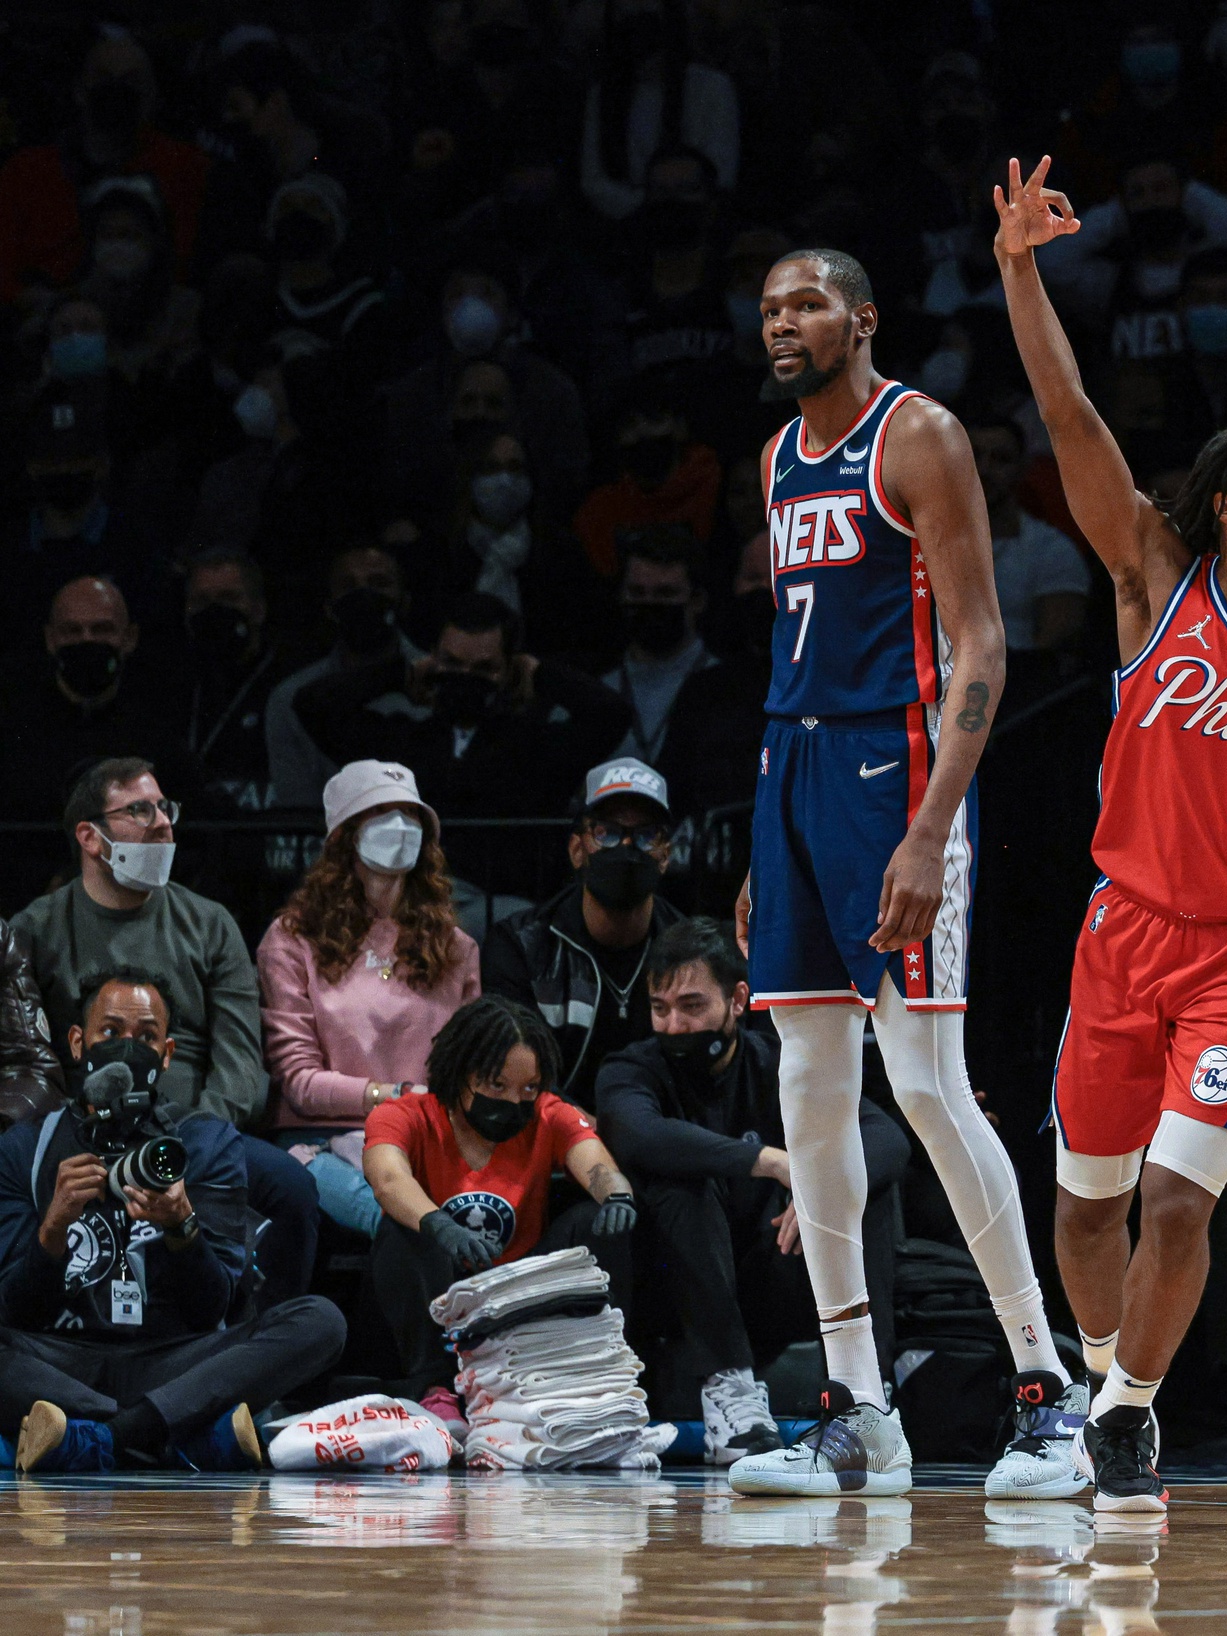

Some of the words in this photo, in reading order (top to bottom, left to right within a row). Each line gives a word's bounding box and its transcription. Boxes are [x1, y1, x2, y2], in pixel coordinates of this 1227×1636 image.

[1111, 311, 1182, 359] NET
[839, 466, 863, 475] Webull
[770, 492, 865, 572] NETS
[785, 581, 815, 663] 7
[447, 1194, 511, 1219] ROOKLYN
